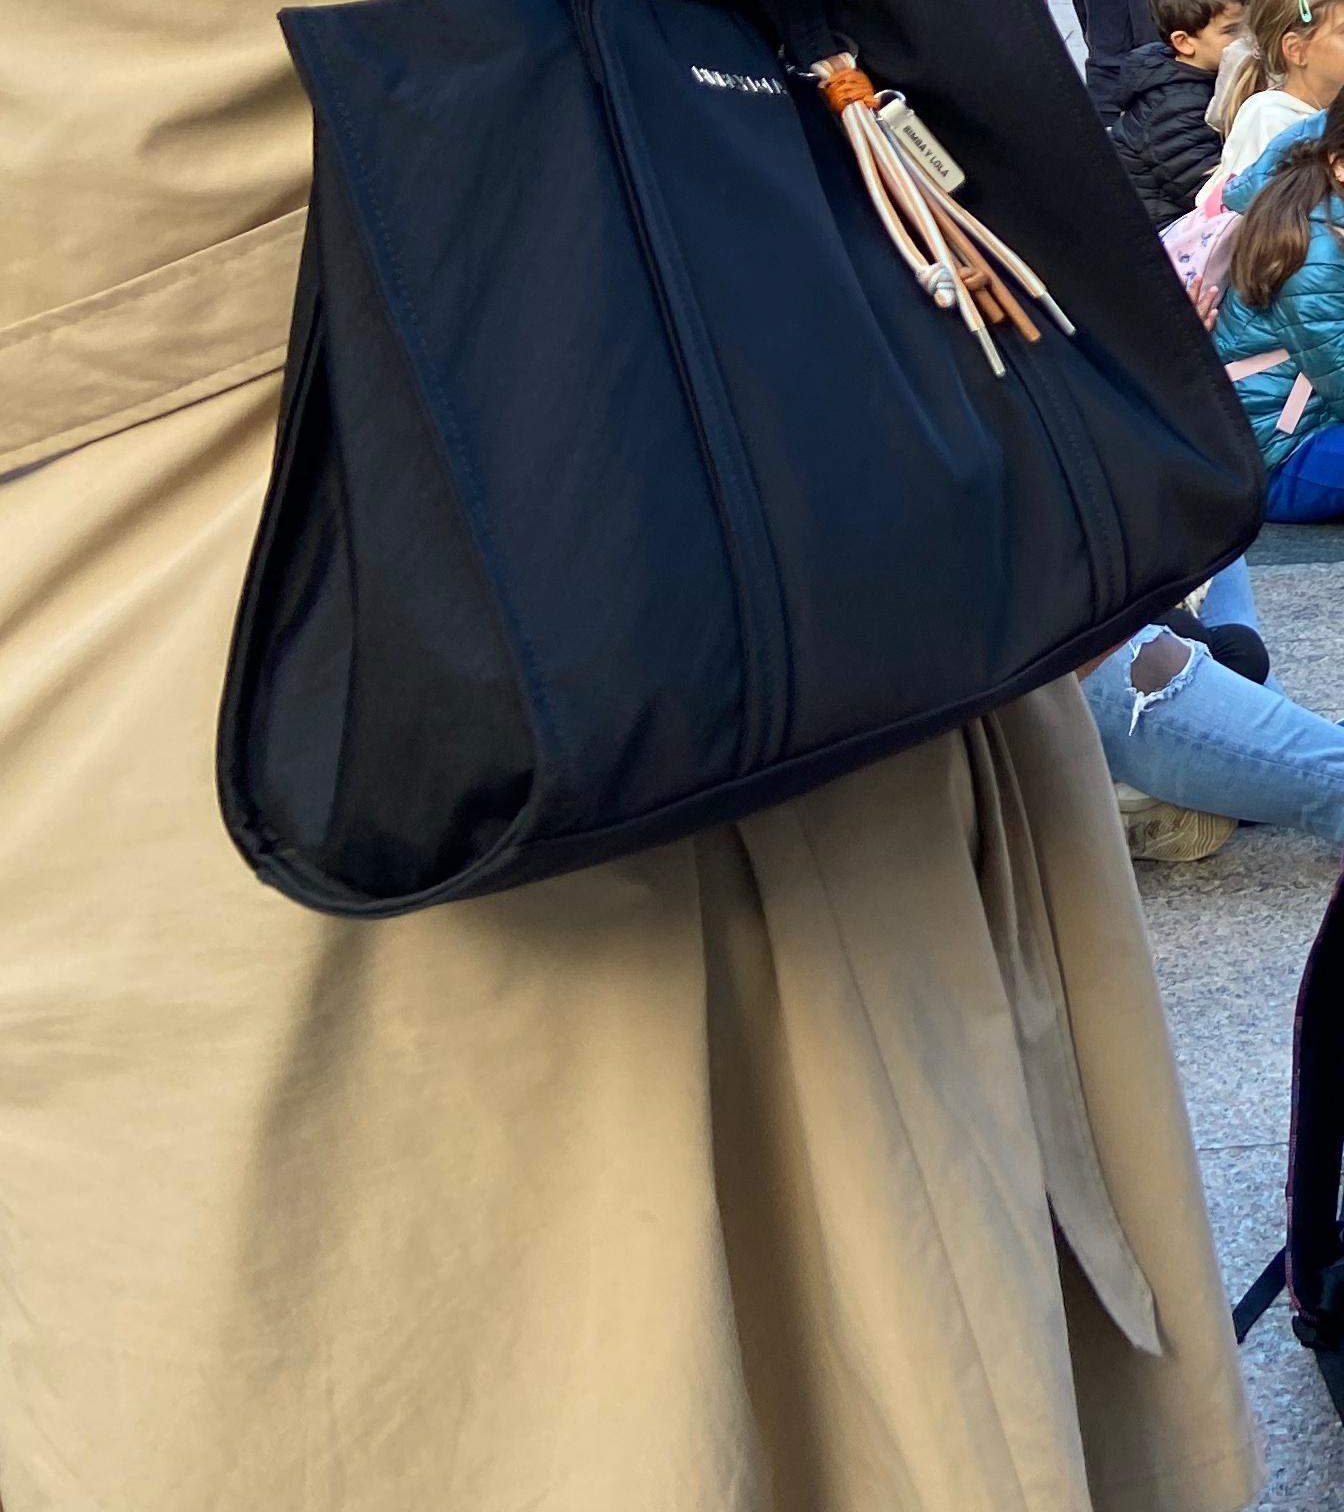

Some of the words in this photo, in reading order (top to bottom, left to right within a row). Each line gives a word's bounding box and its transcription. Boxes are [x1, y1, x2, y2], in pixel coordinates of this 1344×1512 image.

[903, 125, 926, 153] BIMBA
[924, 149, 932, 158] Y
[930, 154, 949, 177] LOLA
